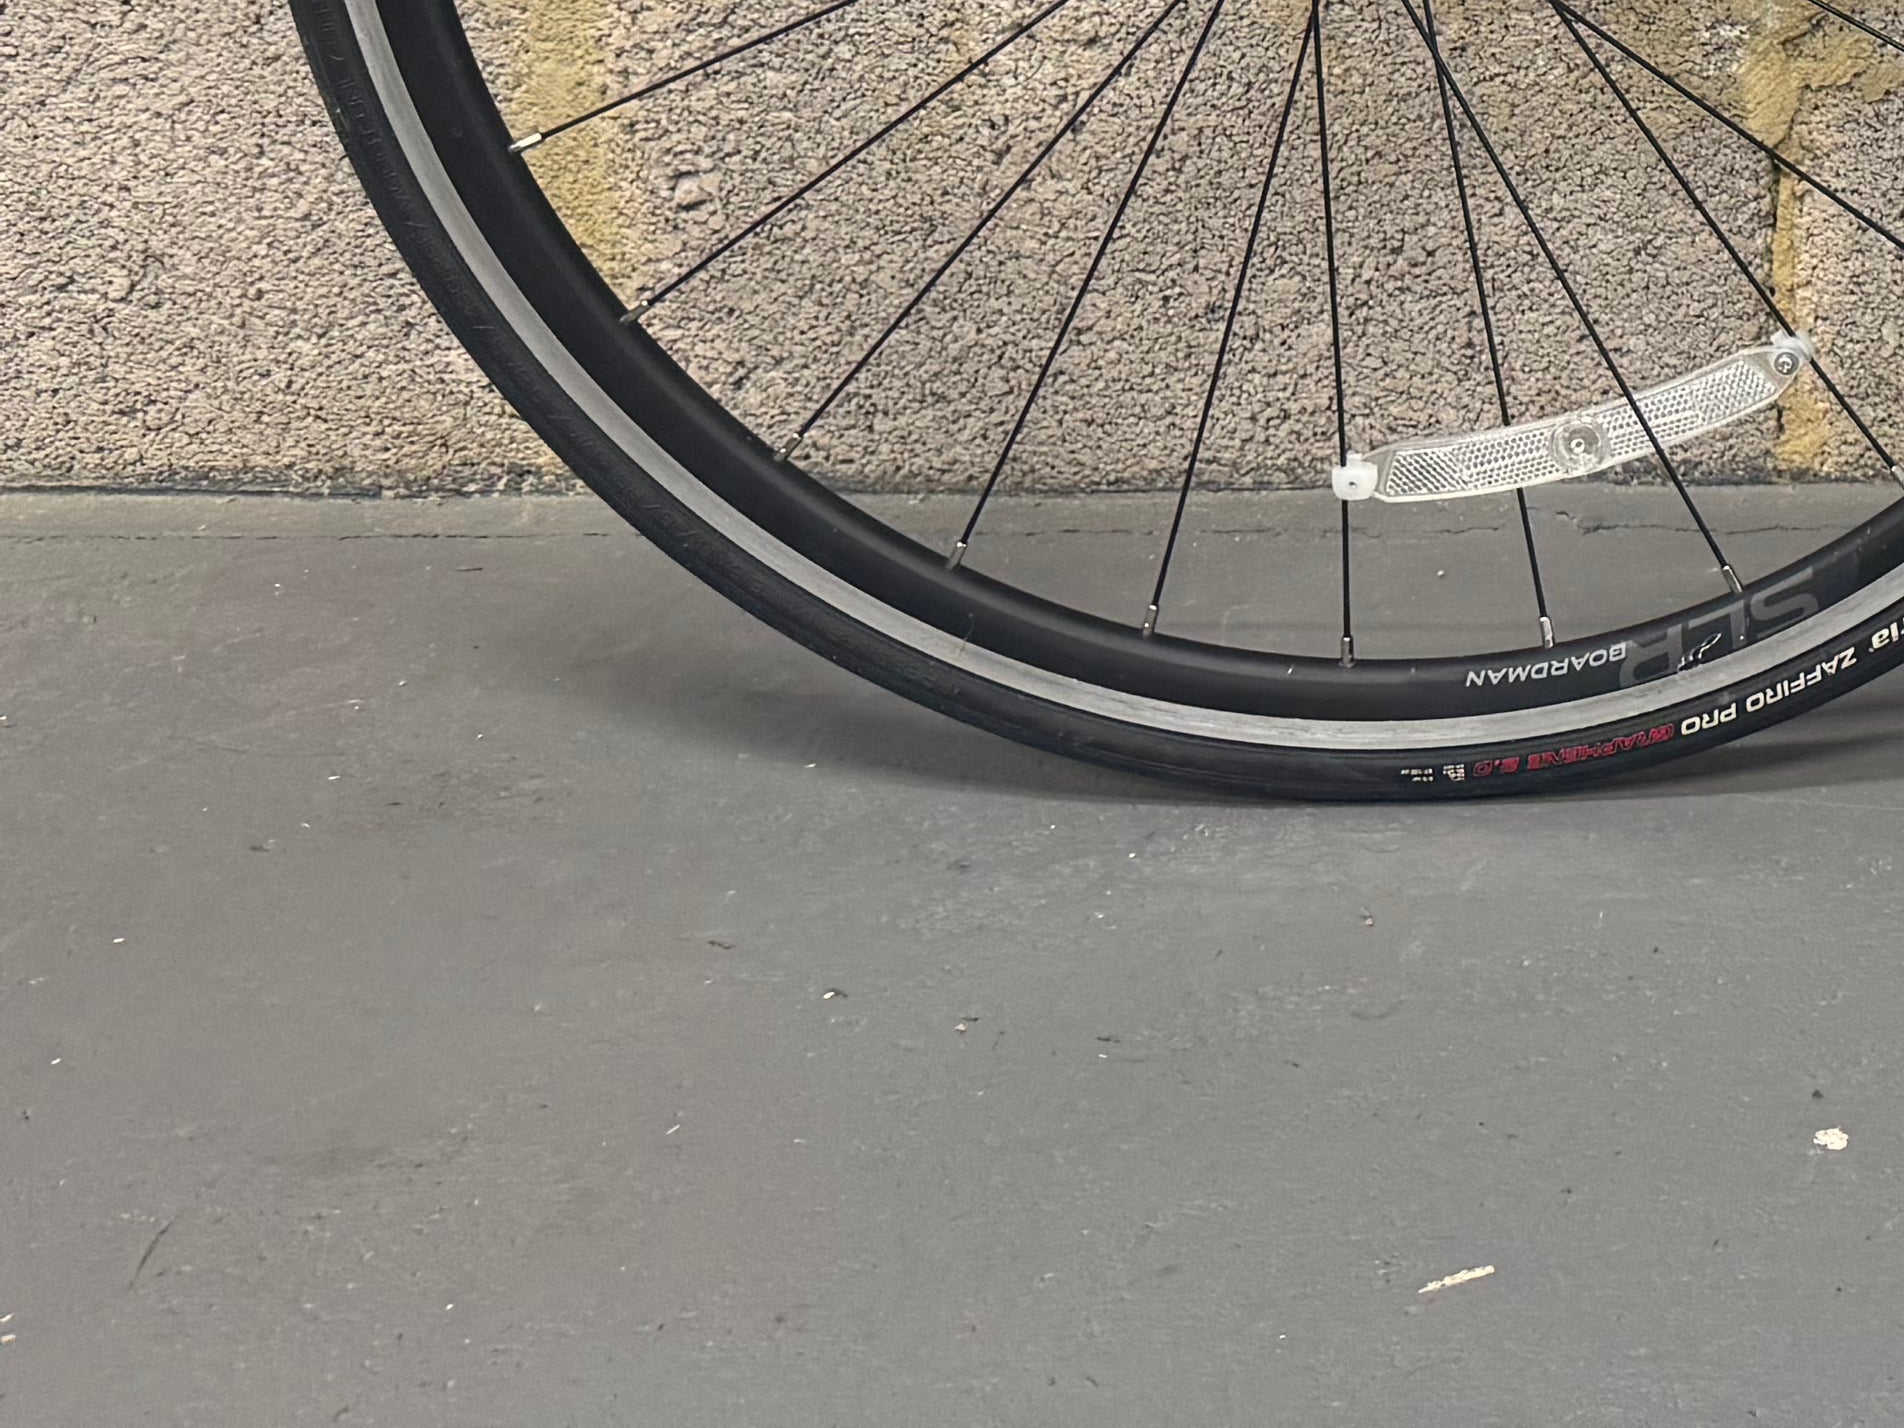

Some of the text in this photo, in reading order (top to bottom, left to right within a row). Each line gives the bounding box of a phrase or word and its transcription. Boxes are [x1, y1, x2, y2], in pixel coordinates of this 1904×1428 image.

[1464, 568, 1821, 691] SLR BOARDMAN
[1745, 653, 1859, 713] ZAFFIRO
[1681, 702, 1739, 737] PRO
